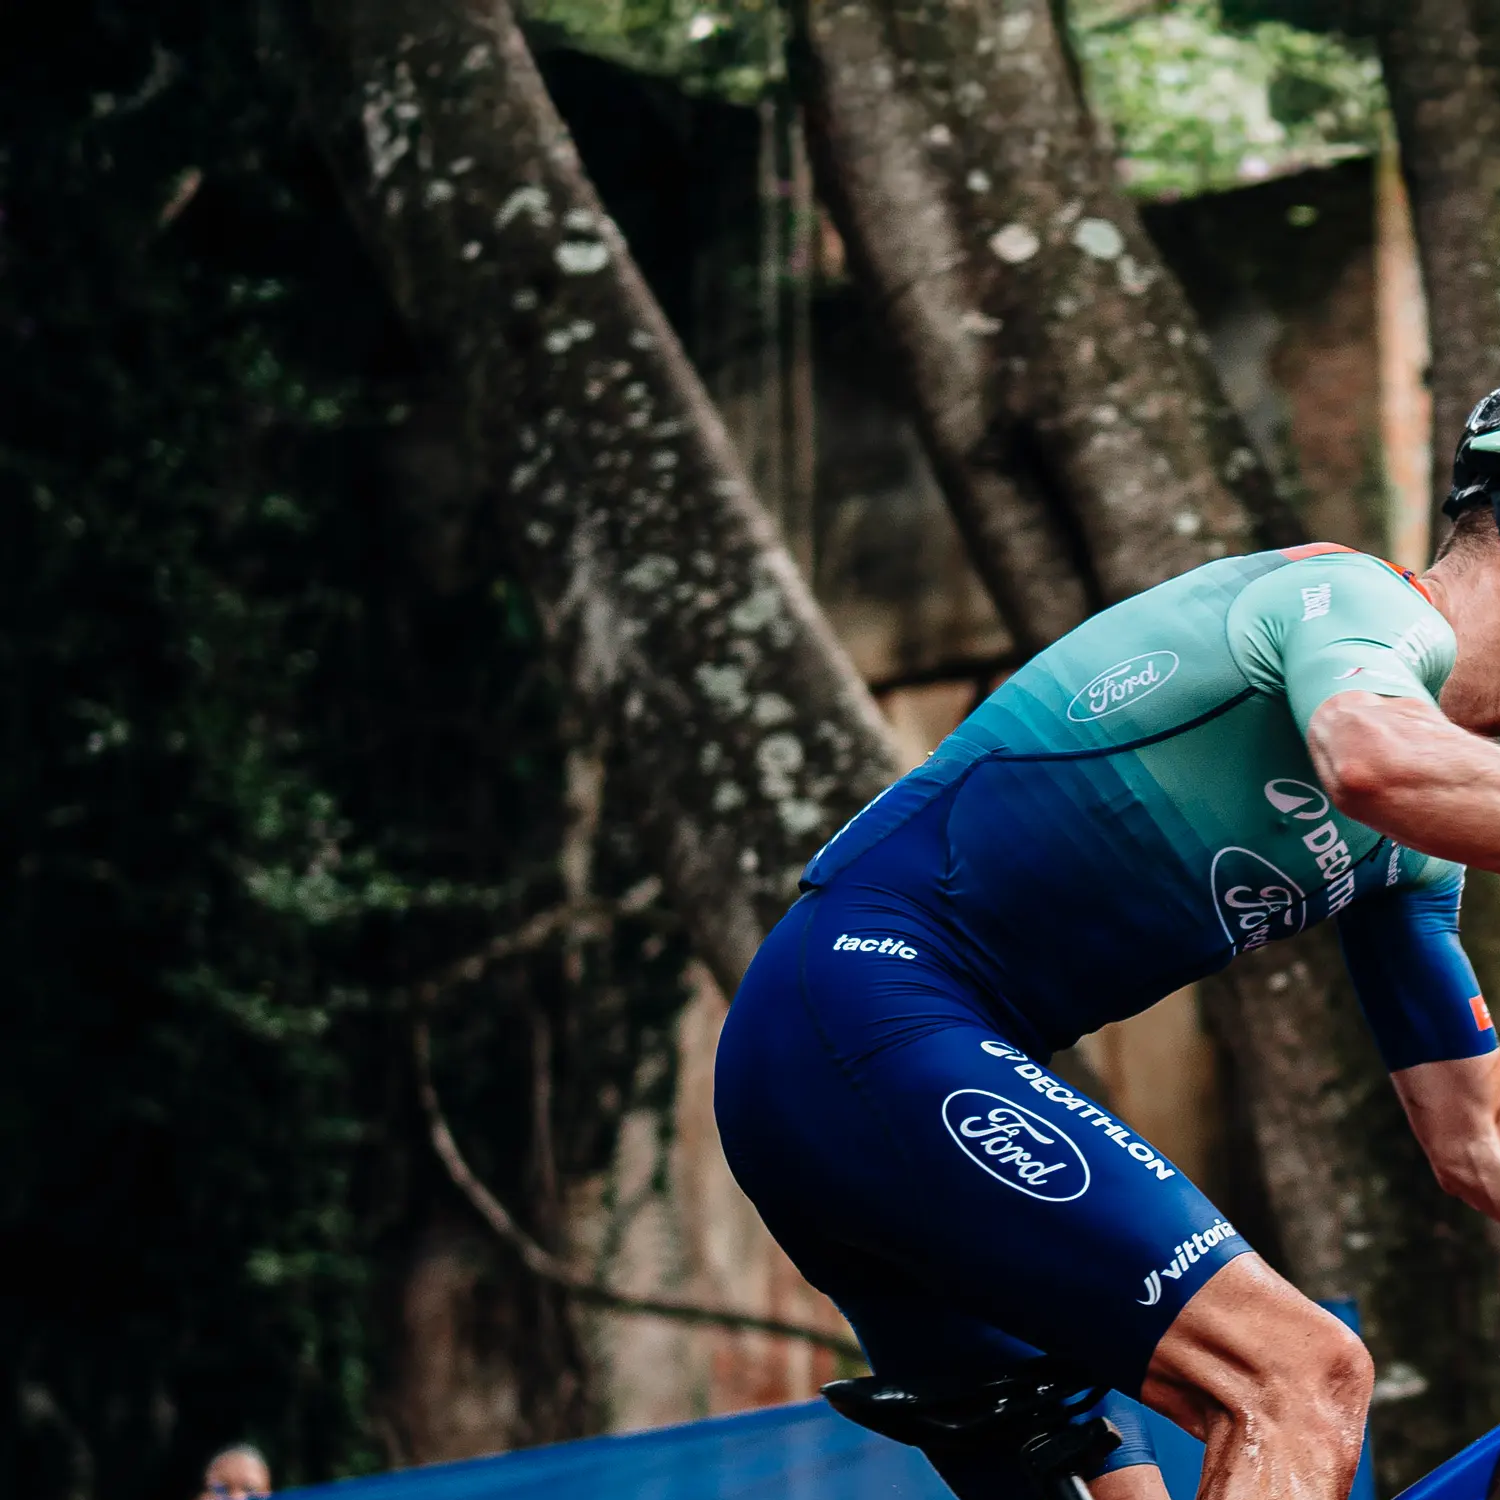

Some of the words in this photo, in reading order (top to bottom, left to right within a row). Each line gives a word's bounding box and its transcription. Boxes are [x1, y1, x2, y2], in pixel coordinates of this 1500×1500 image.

[1088, 658, 1161, 714] Ford
[833, 933, 918, 961] tactic
[960, 1107, 1067, 1186] Ford
[1013, 1062, 1176, 1182] DECATHLON
[1160, 1218, 1235, 1282] vittoria
